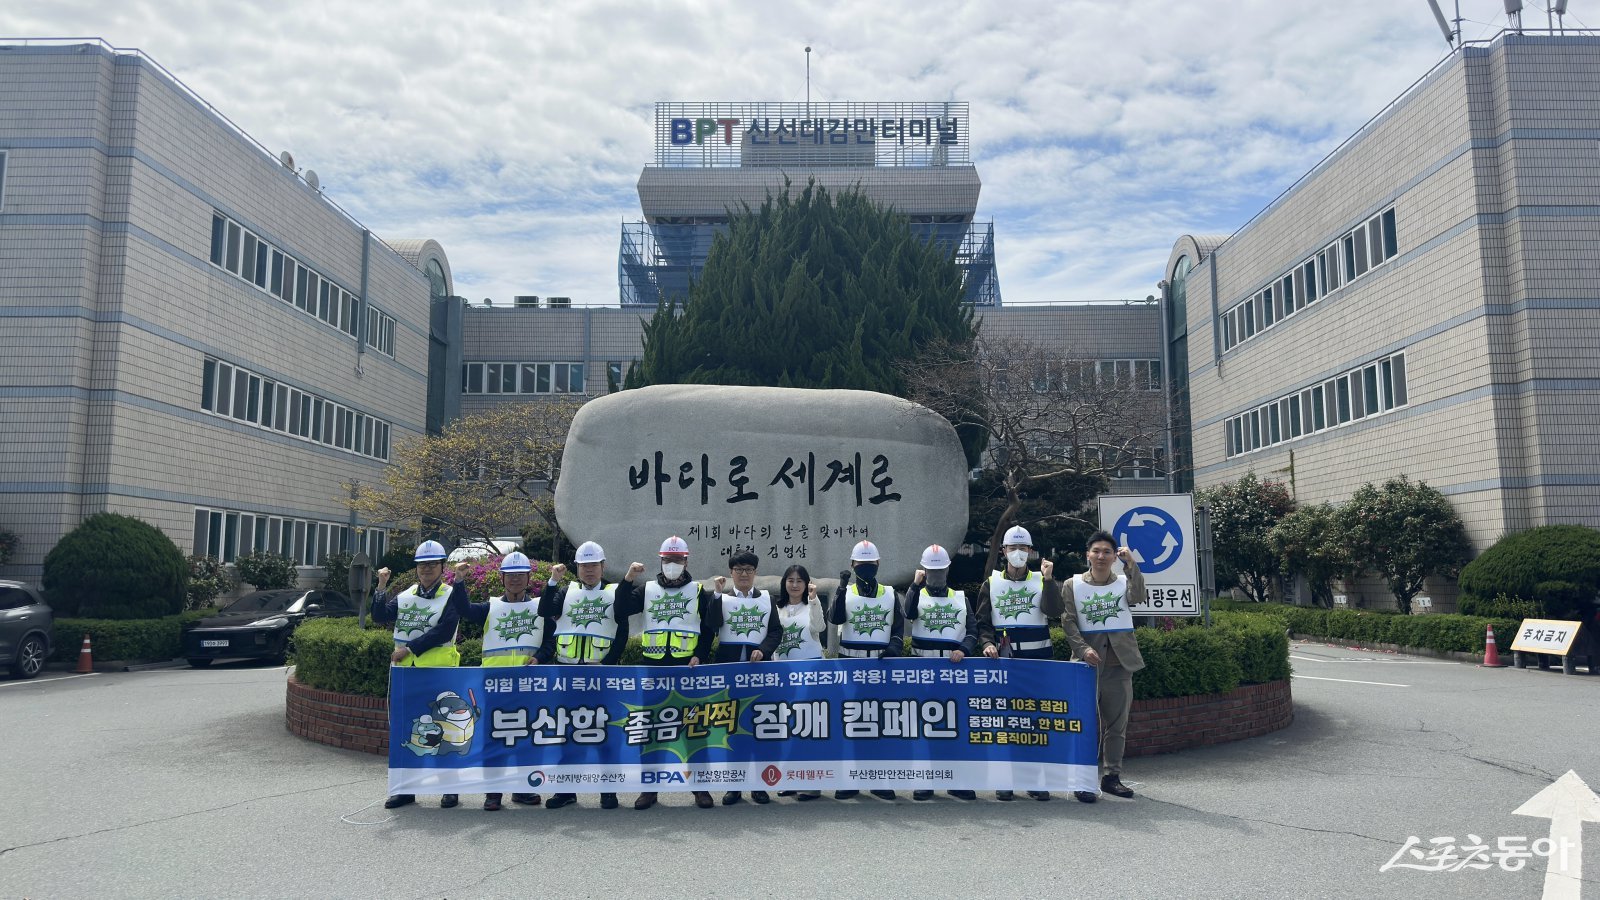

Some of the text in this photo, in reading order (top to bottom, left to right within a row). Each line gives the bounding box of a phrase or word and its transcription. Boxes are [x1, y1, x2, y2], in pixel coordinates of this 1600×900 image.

[671, 117, 959, 145] BPT 신선대감만터미널
[629, 451, 901, 506] 바다로 세계로
[688, 524, 869, 541] 제1회 바다의 날을 맞이하여
[1523, 628, 1566, 643] 주차금지
[484, 669, 1008, 692] 위험 발견 시 즉시 작업 중지! 안전모, 안전화, 안전조끼 착용! 무리한 작업 금지!
[968, 697, 1068, 713] 작업 전 10초 점검!
[491, 706, 609, 746] 부산항
[752, 701, 829, 739] 잠깨
[843, 700, 958, 738] 캠페인
[969, 716, 1081, 732] 중장비 주변, 한 번 더
[969, 732, 1047, 745] 보고 움직이기!
[641, 771, 685, 783] BPA
[697, 770, 746, 779] 부산항만공사
[786, 770, 835, 781] 롯데웰푸드
[849, 769, 953, 781] 부산항만안전관리협의회
